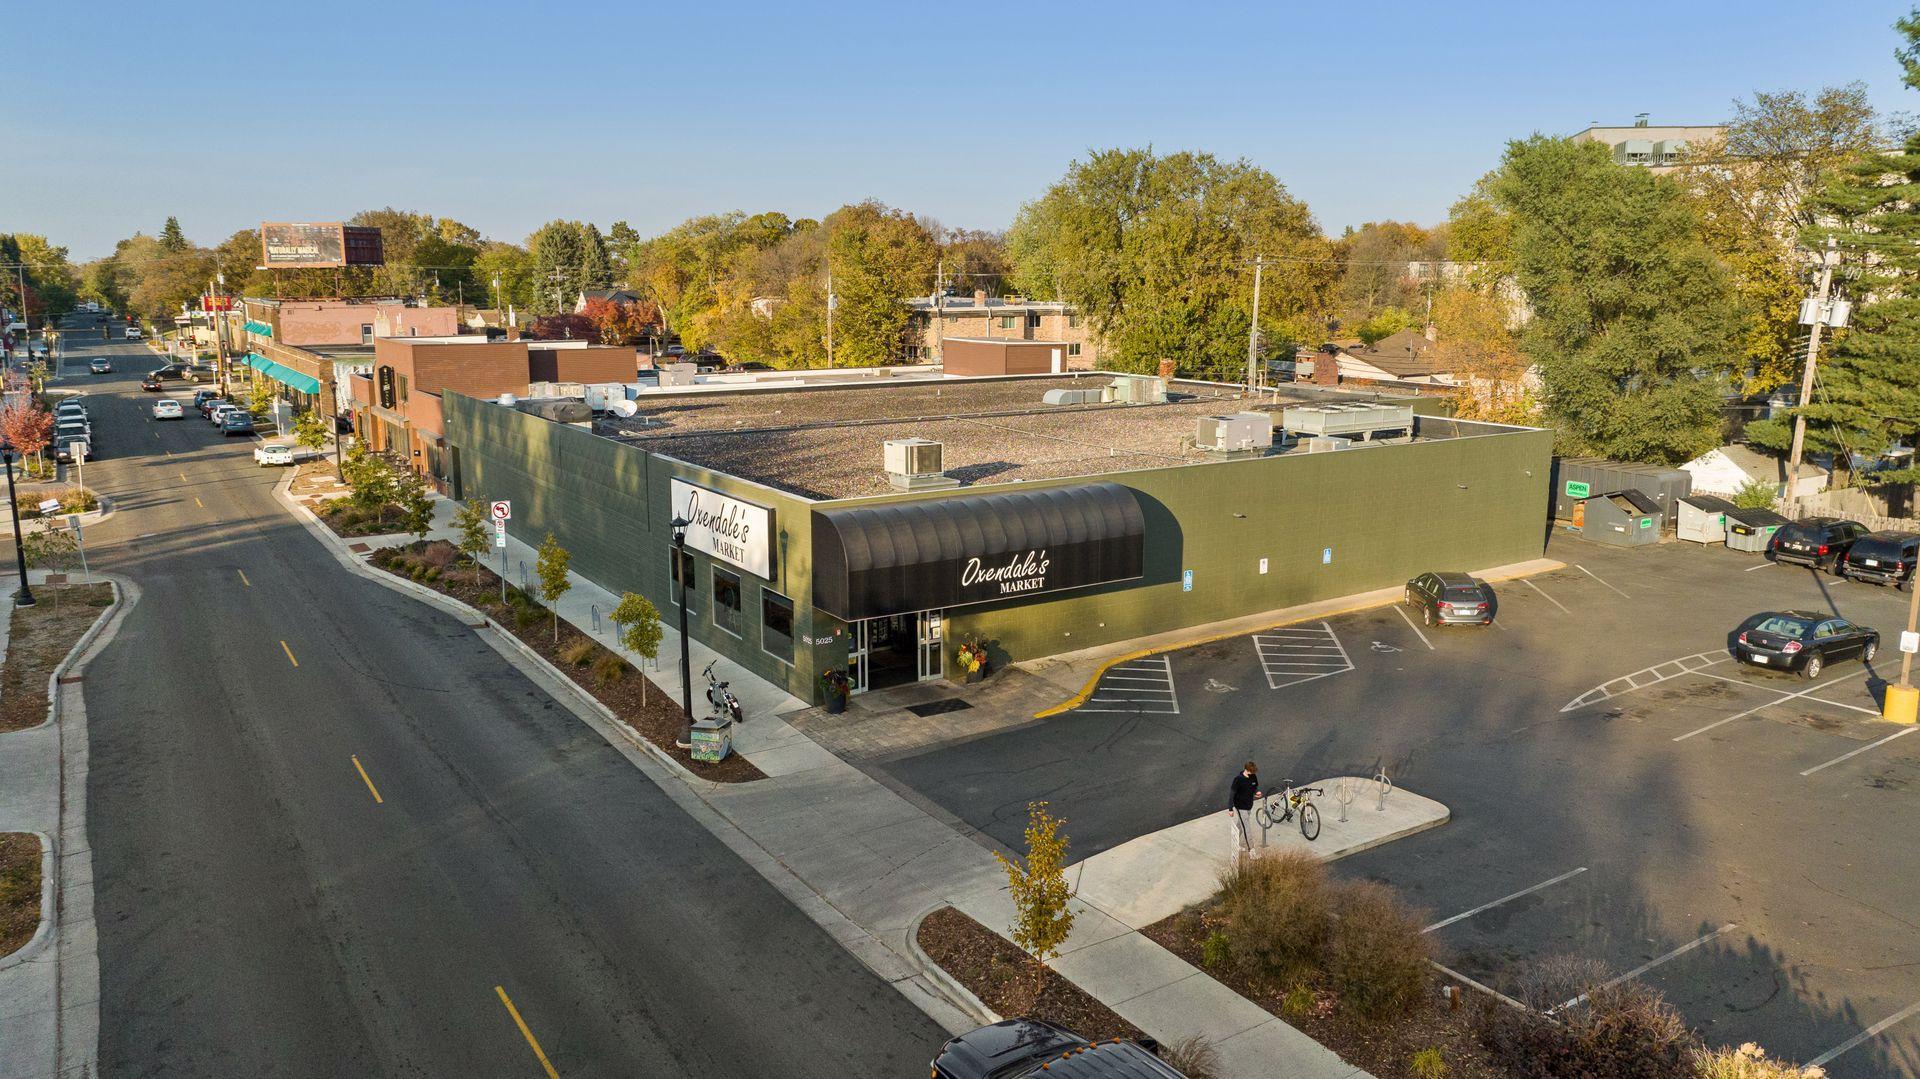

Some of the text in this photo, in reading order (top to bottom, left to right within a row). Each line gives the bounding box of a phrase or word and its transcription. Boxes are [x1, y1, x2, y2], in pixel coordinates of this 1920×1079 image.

[688, 490, 750, 543] Oxendale's
[713, 537, 745, 563] MARKET
[962, 550, 1050, 587] Oxendale's
[1000, 577, 1045, 594] MARKET
[815, 636, 833, 646] 5025
